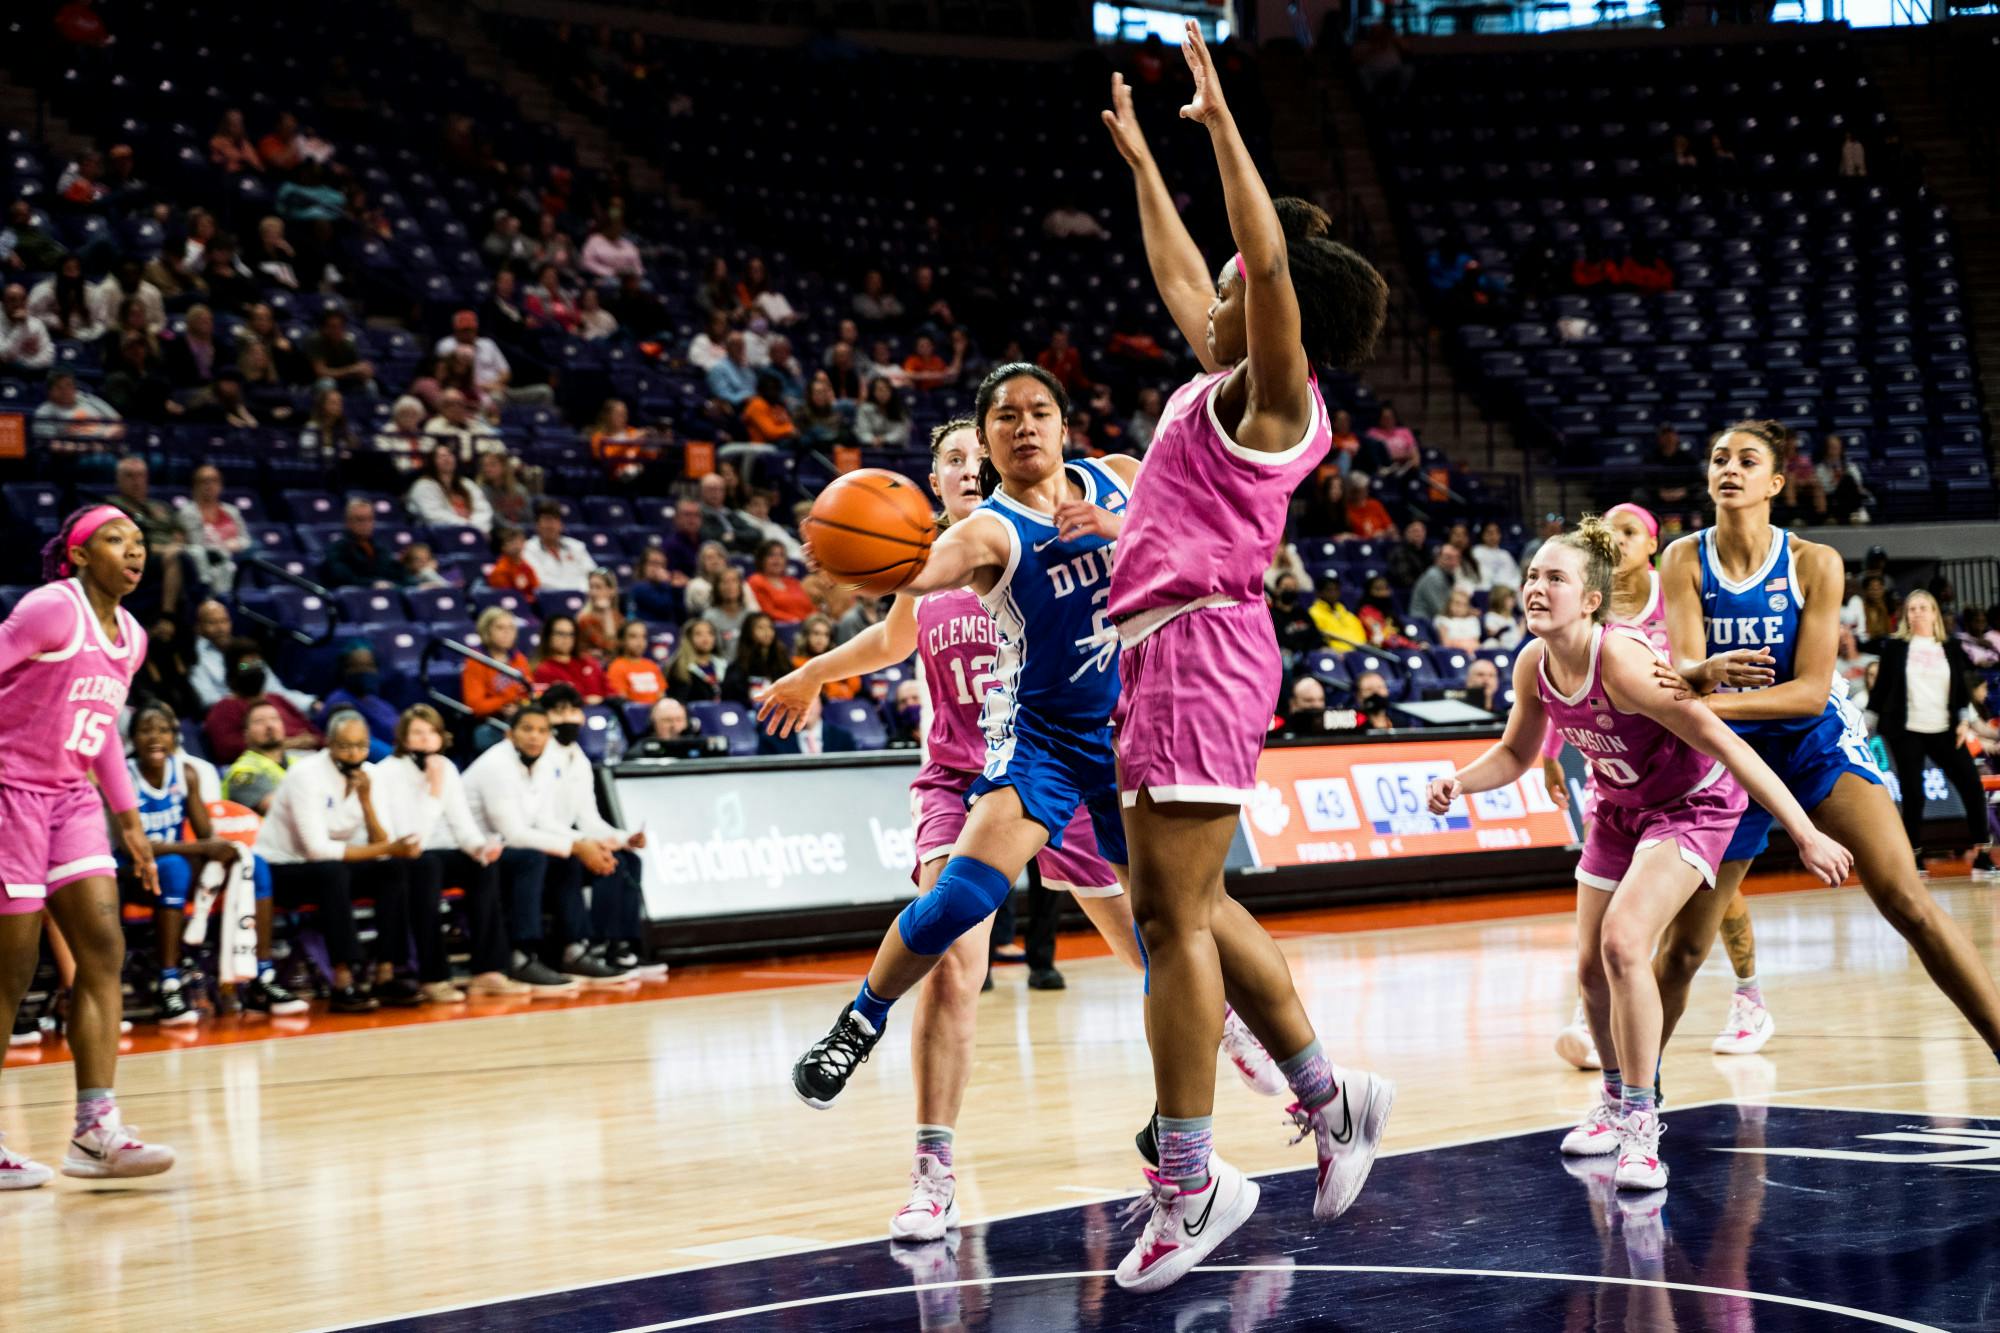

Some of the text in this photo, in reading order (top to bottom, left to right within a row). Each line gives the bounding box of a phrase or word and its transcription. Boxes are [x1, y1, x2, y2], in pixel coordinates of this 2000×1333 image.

[1047, 541, 1117, 599] DUK
[929, 615, 999, 657] CLEMSO
[64, 708, 113, 757] 15
[1377, 776, 1438, 814] 05
